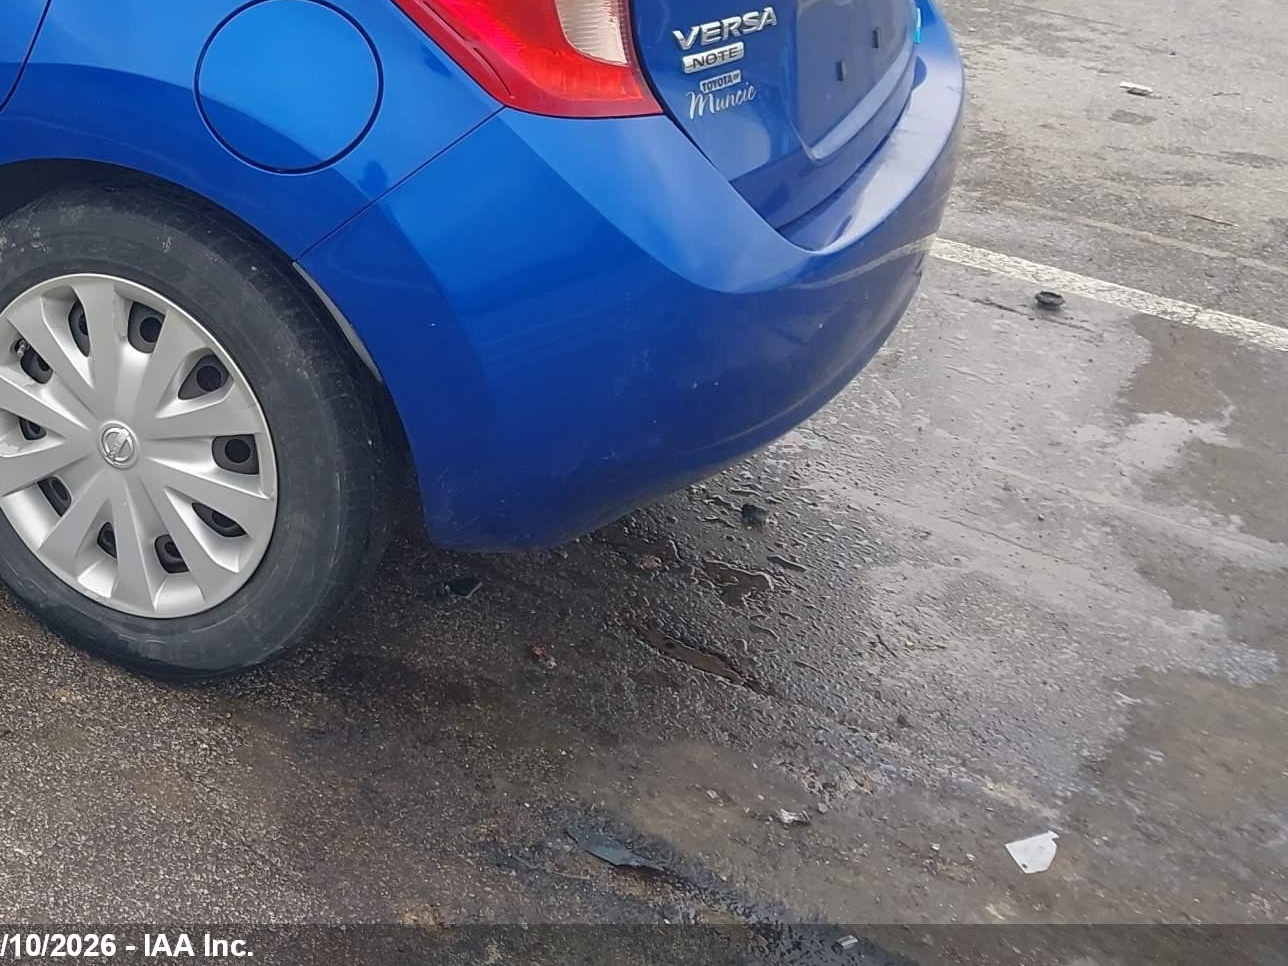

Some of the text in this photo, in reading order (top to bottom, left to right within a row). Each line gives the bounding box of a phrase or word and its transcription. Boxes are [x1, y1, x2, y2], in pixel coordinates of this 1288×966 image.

[673, 6, 777, 50] VERSA
[693, 46, 738, 68] NOTE
[702, 75, 733, 91] TOYOTA
[687, 82, 757, 120] Muncie
